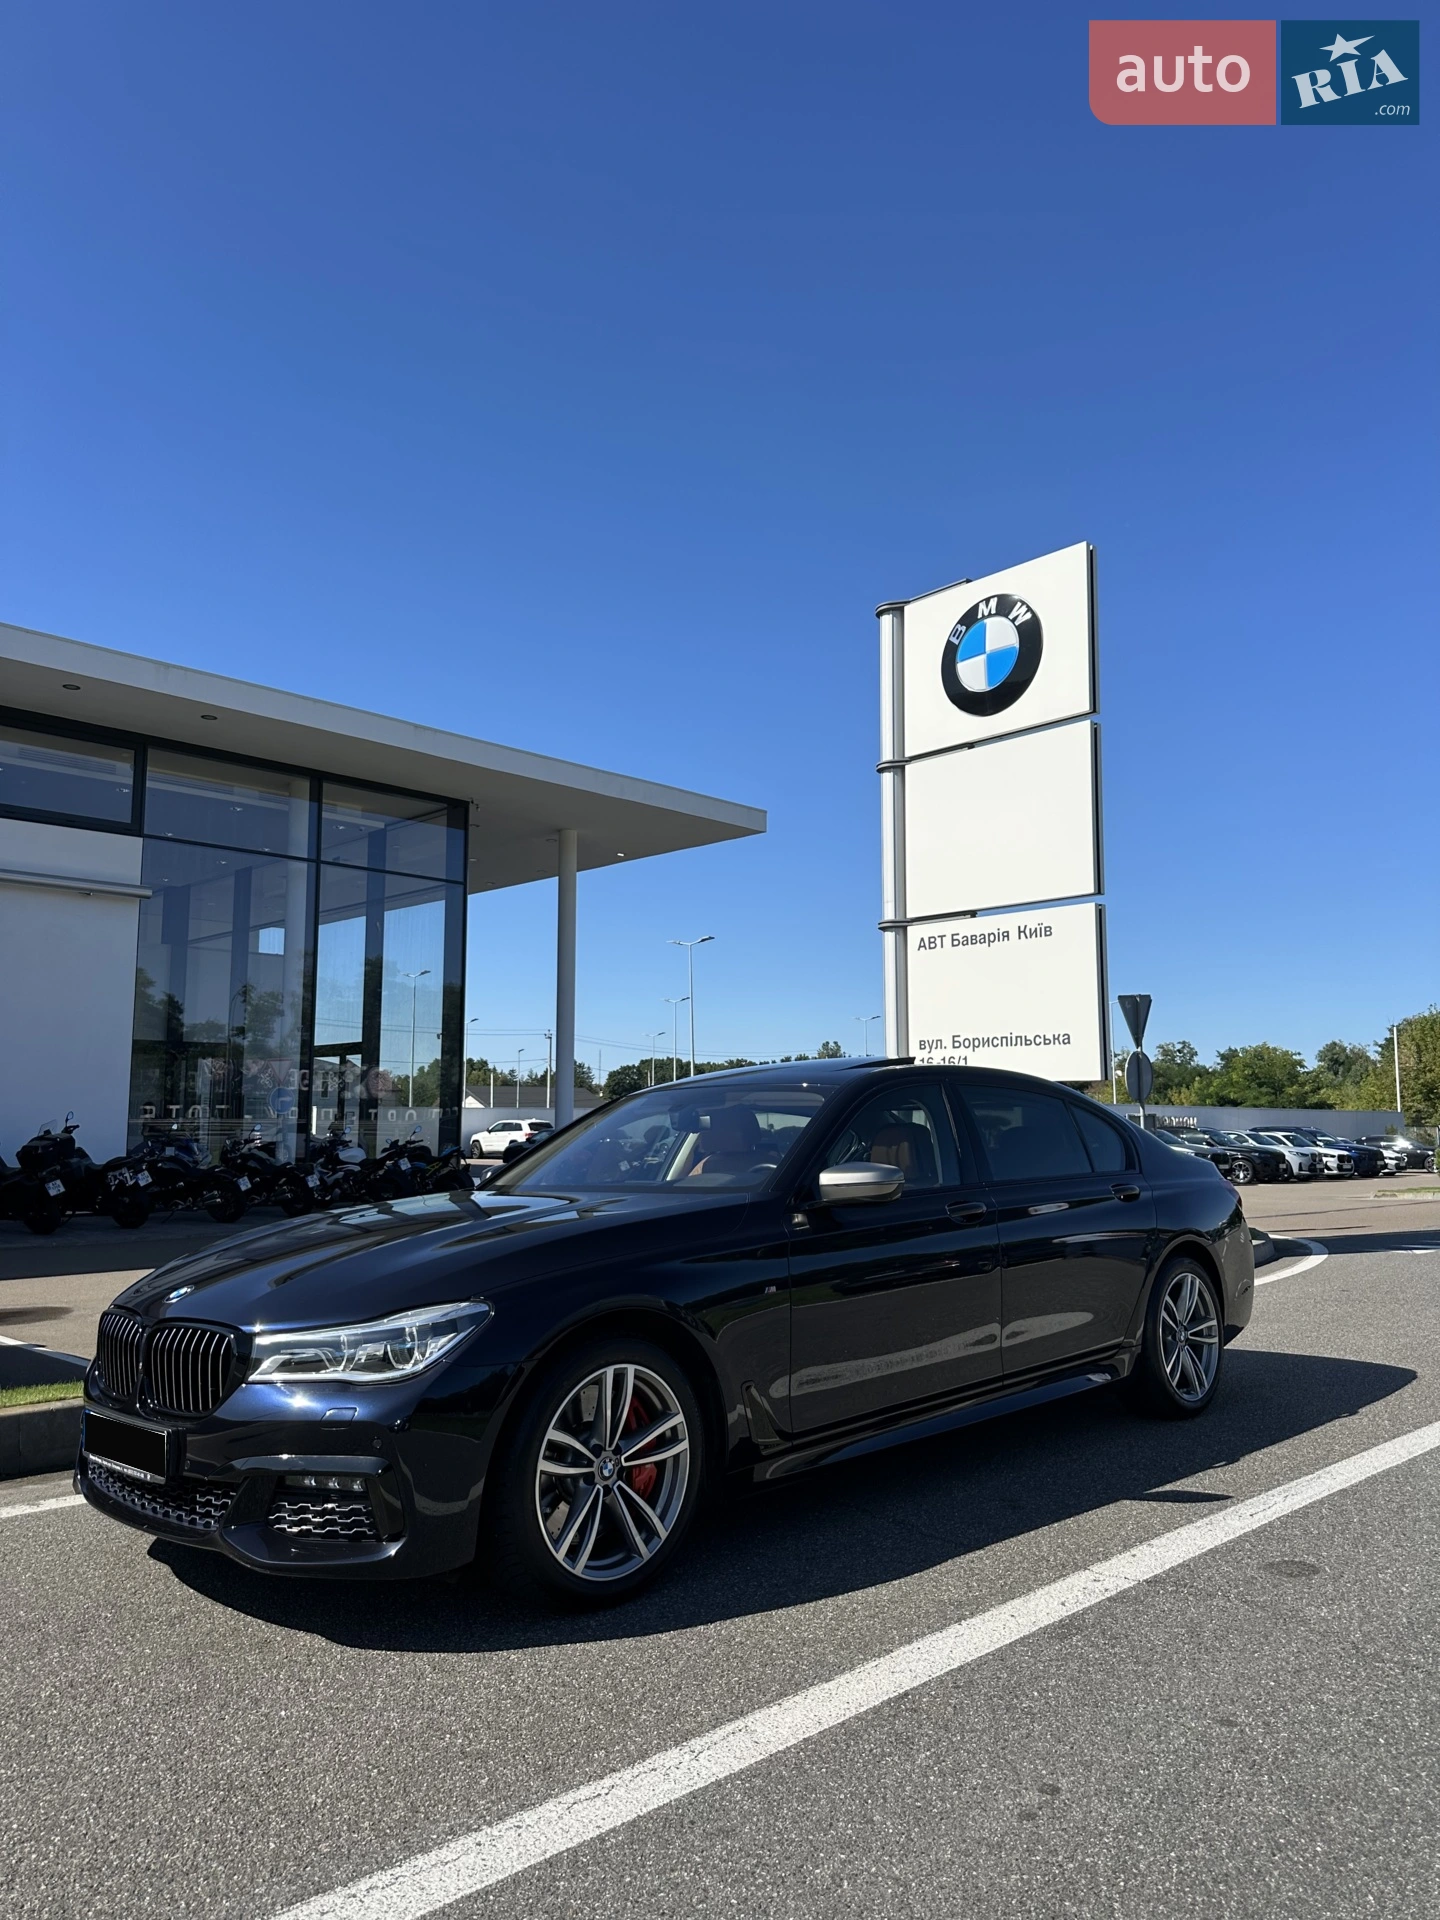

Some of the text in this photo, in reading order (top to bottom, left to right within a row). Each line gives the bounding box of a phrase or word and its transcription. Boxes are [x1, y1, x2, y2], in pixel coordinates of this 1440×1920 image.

[949, 597, 1032, 645] BMW
[917, 923, 1053, 951] АВТ Баварія Київ
[919, 1032, 1071, 1053] вул. Бориспільська
